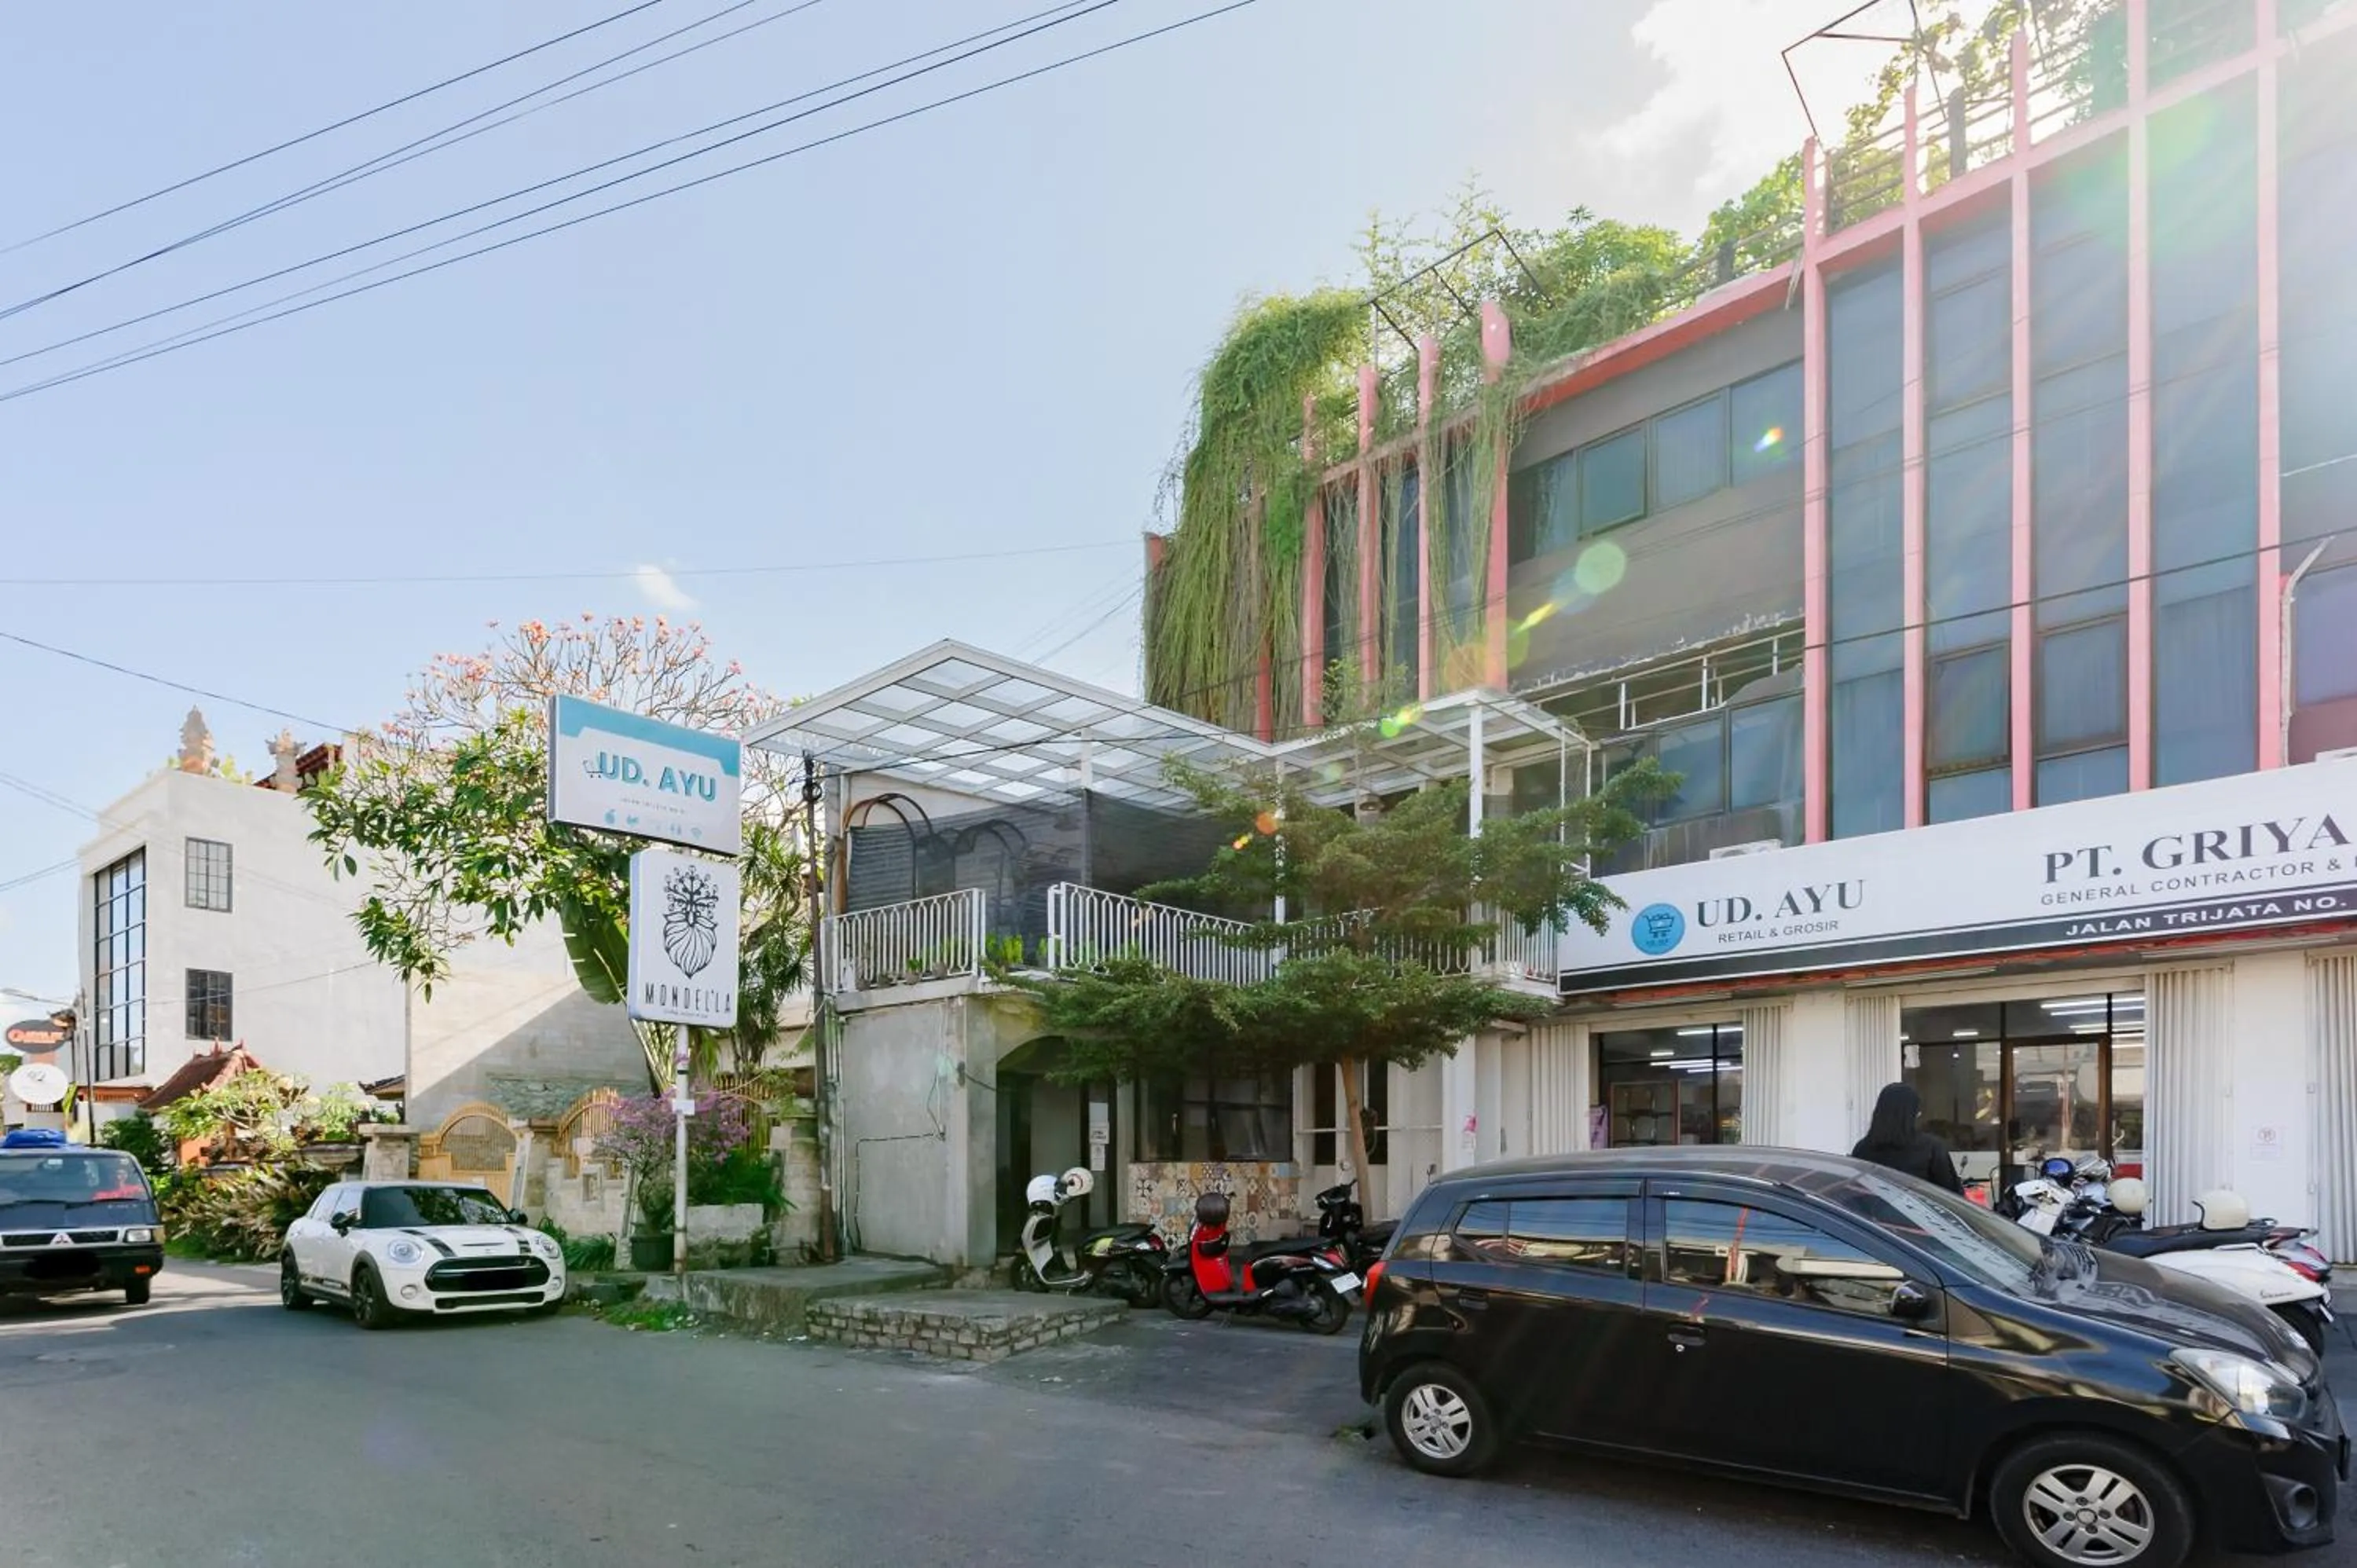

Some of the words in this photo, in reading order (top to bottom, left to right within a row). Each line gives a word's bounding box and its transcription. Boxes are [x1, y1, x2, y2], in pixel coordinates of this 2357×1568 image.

[599, 751, 649, 786] UD.
[658, 766, 716, 802] AYU
[2043, 845, 2122, 884] PT.
[2142, 814, 2352, 870] GRIYA
[1697, 896, 1763, 928] UD.
[1775, 879, 1867, 918] AYU
[2041, 884, 2139, 906] GENERAL
[2151, 862, 2315, 892] CONTRACTOR
[2327, 857, 2341, 871] &
[1718, 929, 1765, 943] RETAIL
[1769, 927, 1779, 938] &
[1783, 920, 1839, 936] GROSIR
[2066, 916, 2151, 936] JALAN
[2164, 903, 2282, 926] TRIJATA
[2293, 896, 2348, 912] NO.
